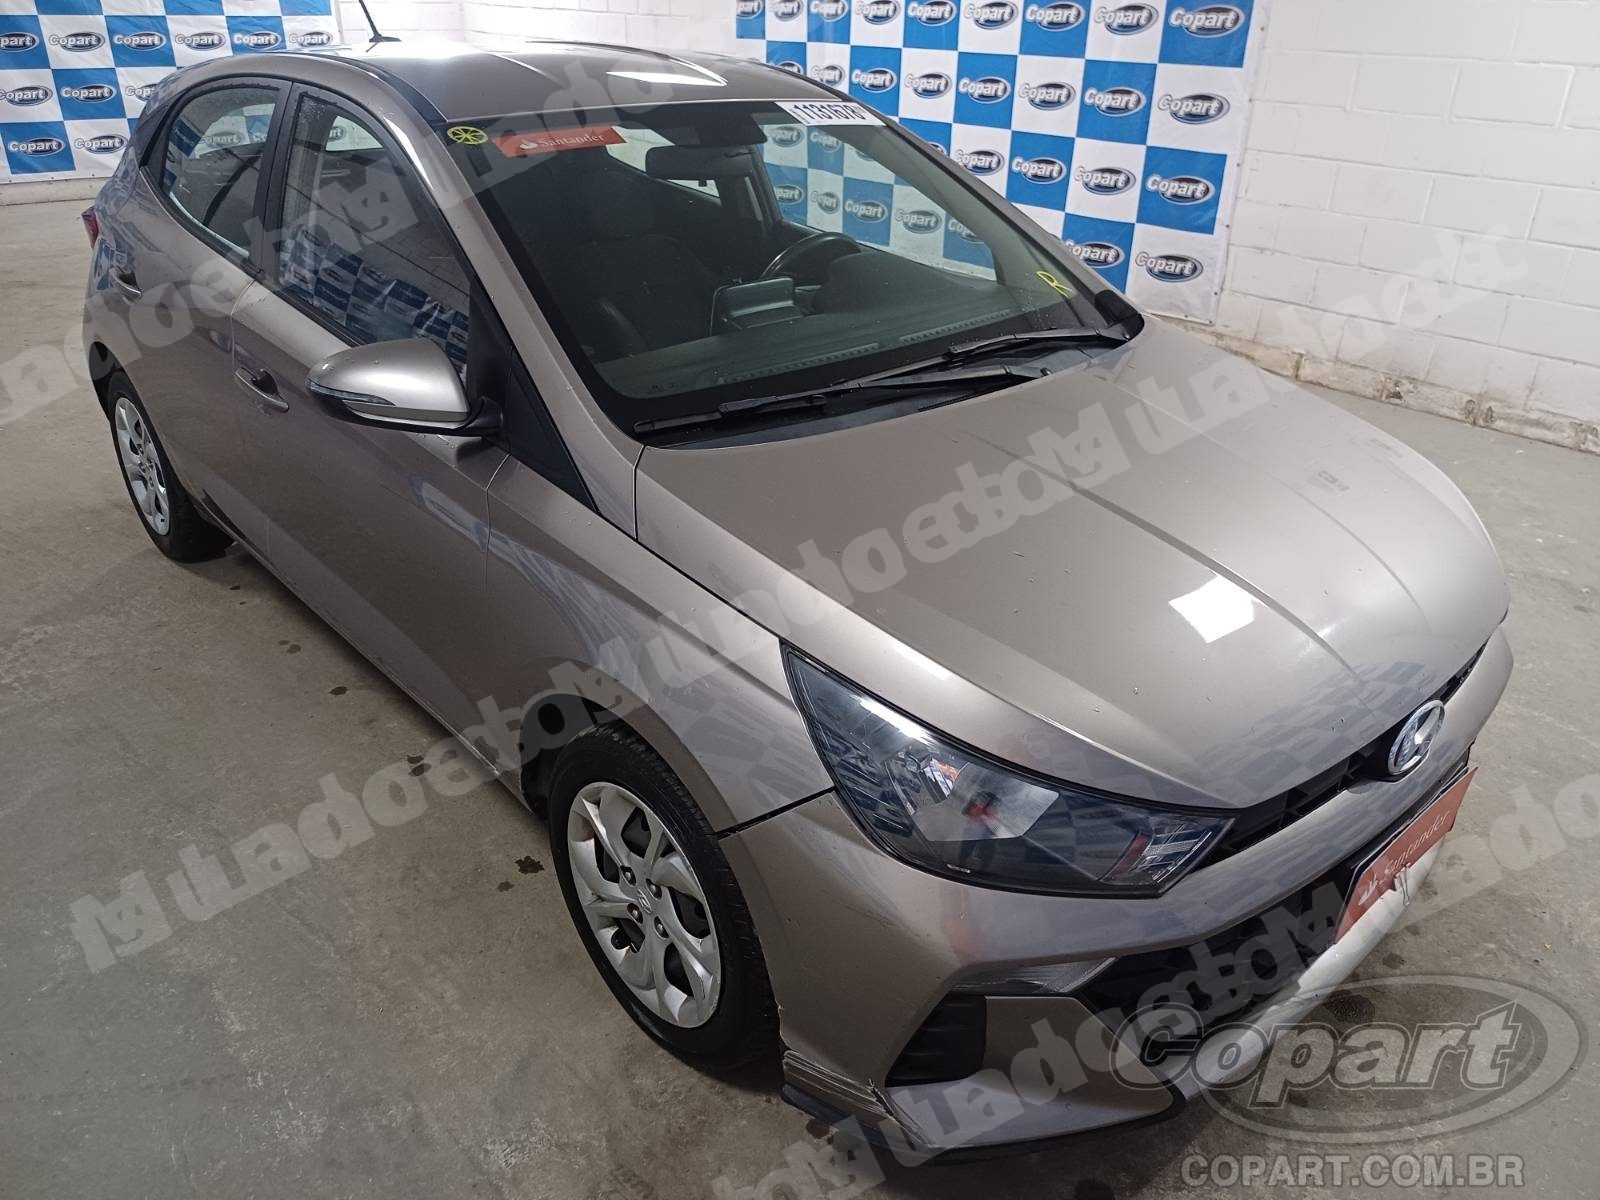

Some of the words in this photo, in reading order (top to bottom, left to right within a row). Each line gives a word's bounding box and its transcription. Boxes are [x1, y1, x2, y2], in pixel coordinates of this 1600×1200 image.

[856, 1, 896, 19] Copart
[908, 2, 952, 21] Copart
[964, 4, 1010, 22] Copart
[1026, 5, 1078, 26] Copart
[1095, 8, 1148, 28] Copart
[1169, 8, 1236, 31] Copart
[48, 33, 98, 49] Copart
[113, 34, 160, 48] Copart
[175, 33, 221, 48] Copart
[233, 32, 276, 47] Copart
[288, 33, 328, 47] Copart
[852, 69, 891, 88] Copart
[905, 73, 947, 92] Copart
[959, 78, 1004, 97] Copart
[61, 85, 111, 100] Copart
[1019, 83, 1068, 104] Copart
[1084, 88, 1138, 110] Copart
[1158, 91, 1219, 118] Copart
[9, 140, 58, 154] Copart
[74, 137, 121, 150] Copart
[538, 131, 605, 148] Santander
[954, 149, 999, 168] Copart
[1012, 156, 1060, 178] Copart
[1075, 165, 1127, 190] Copart
[1147, 174, 1206, 199] Copart
[844, 199, 882, 218] Copart
[895, 208, 936, 228] Copart
[1135, 251, 1193, 278] Copart
[1384, 809, 1450, 877] Santander
